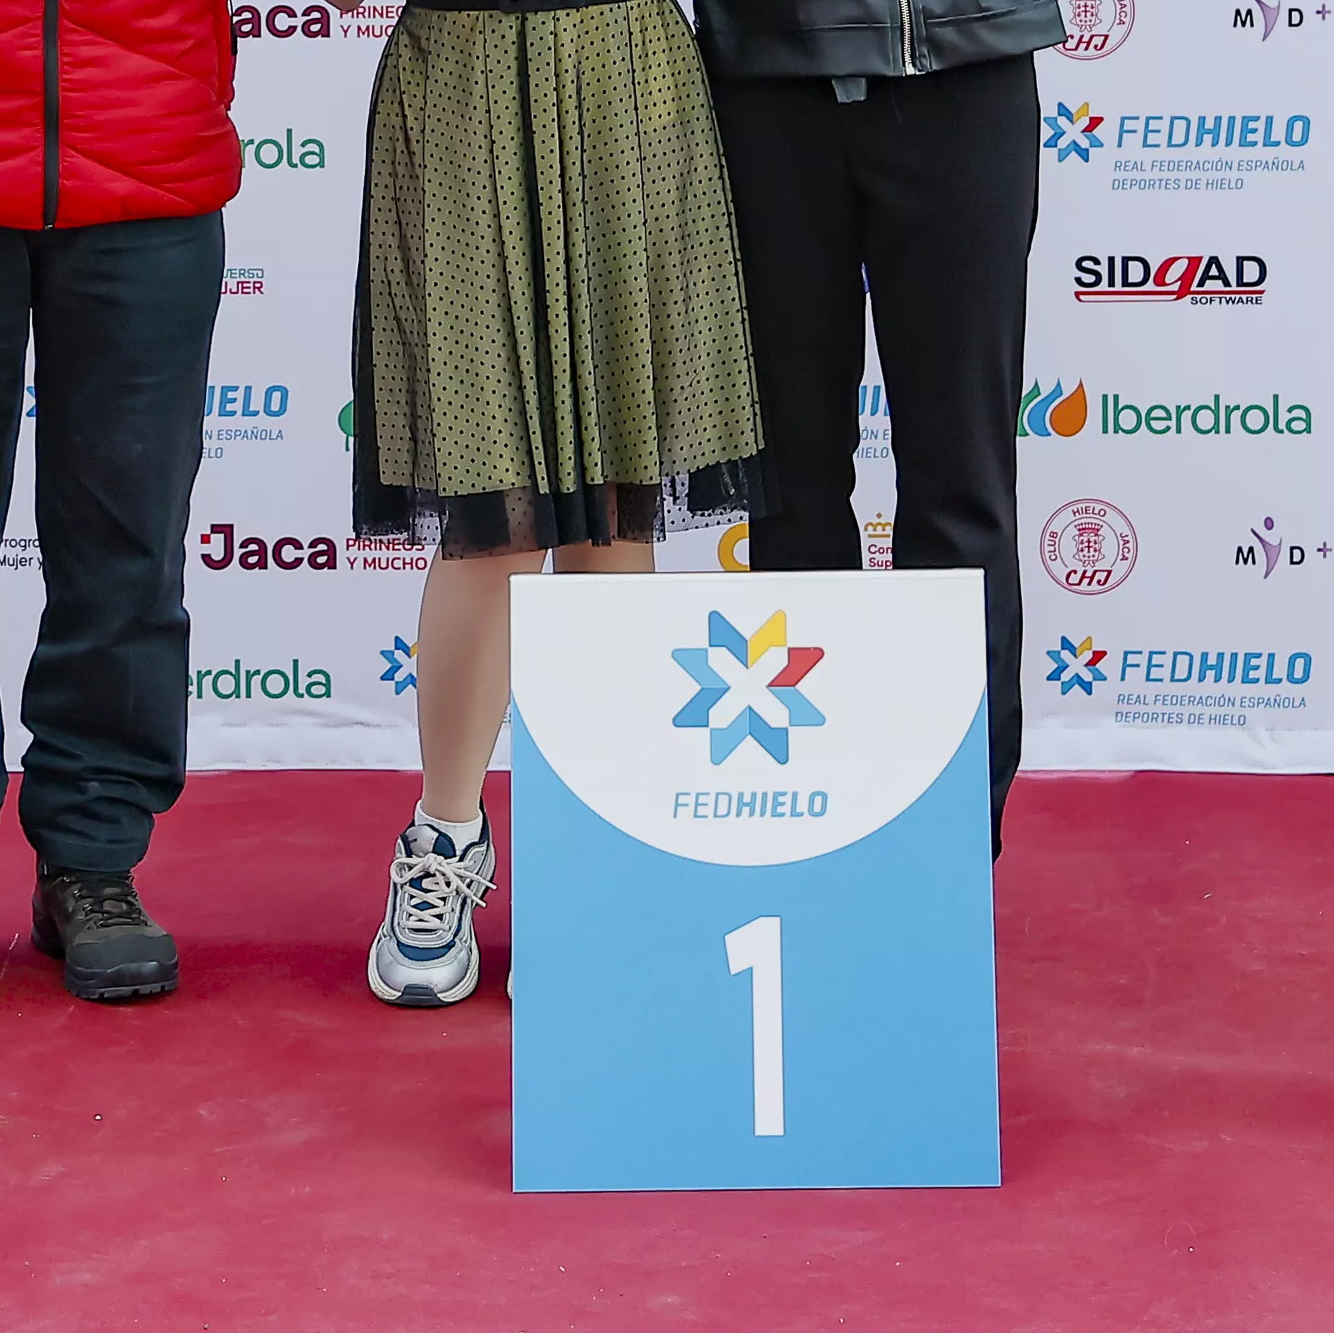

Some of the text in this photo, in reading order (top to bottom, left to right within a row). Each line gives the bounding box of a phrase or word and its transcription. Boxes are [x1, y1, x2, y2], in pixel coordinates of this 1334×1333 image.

[1190, 296, 1263, 305] SOFTWARE
[1120, 651, 1312, 684] FEDHIELO
[673, 791, 828, 818] FEDHIELO
[725, 915, 785, 1135] 1
